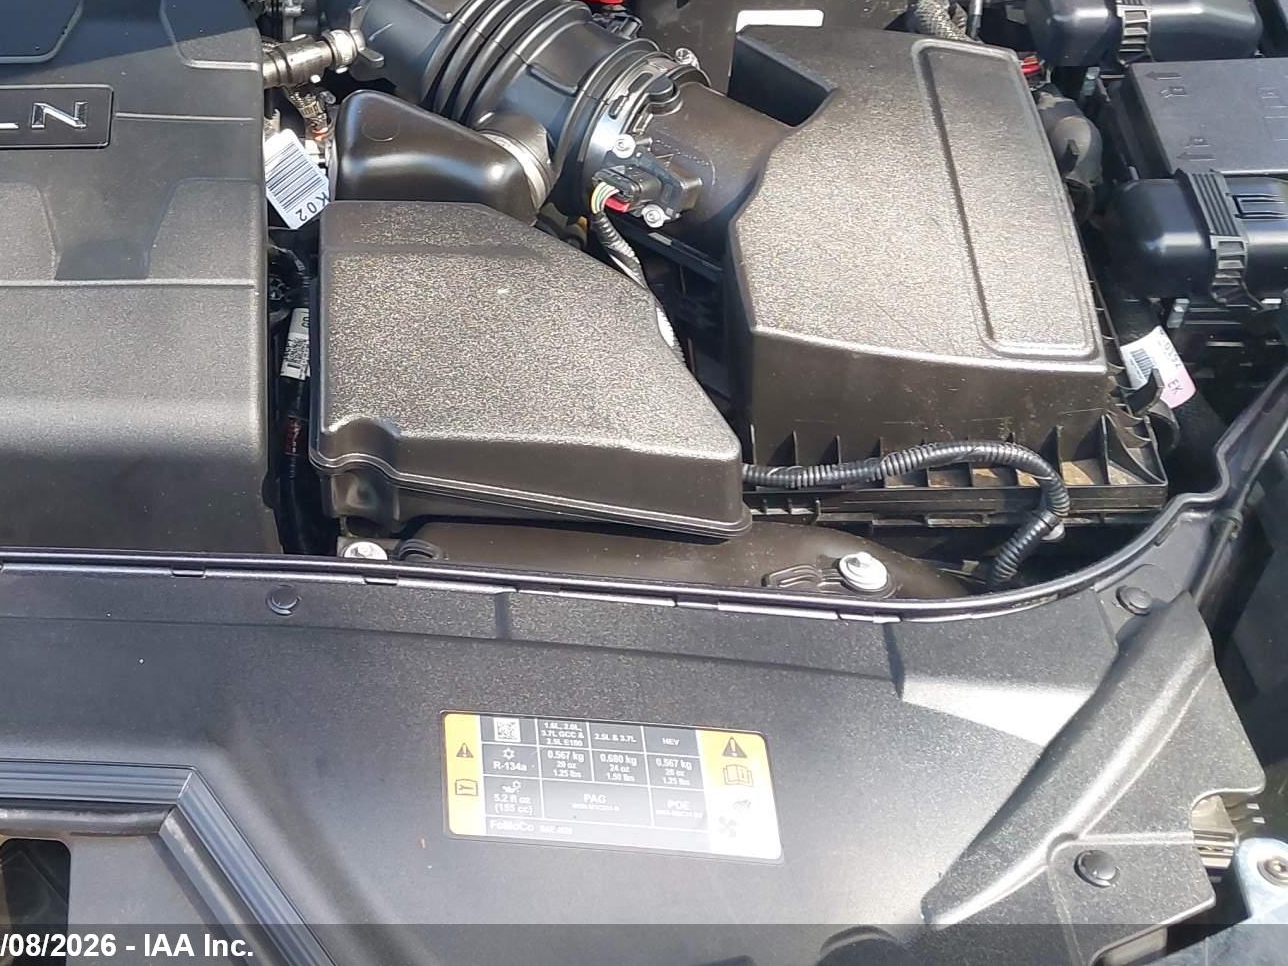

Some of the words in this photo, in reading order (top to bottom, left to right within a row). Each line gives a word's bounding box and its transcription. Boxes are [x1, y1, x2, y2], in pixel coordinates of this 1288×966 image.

[662, 737, 680, 746] HEV
[547, 749, 571, 760] 0.567
[572, 751, 585, 763] kg
[625, 755, 638, 766] kg
[493, 760, 528, 772] R-134a
[609, 764, 619, 772] 24
[656, 758, 679, 768] 0.567
[681, 759, 693, 771] kg
[570, 770, 582, 778] lbs
[493, 793, 508, 804] 5.2
[584, 793, 607, 804] PAG
[494, 803, 514, 814] (155
[516, 805, 533, 816] cc)
[668, 799, 692, 811] POE
[489, 819, 535, 833] FoMoCo
